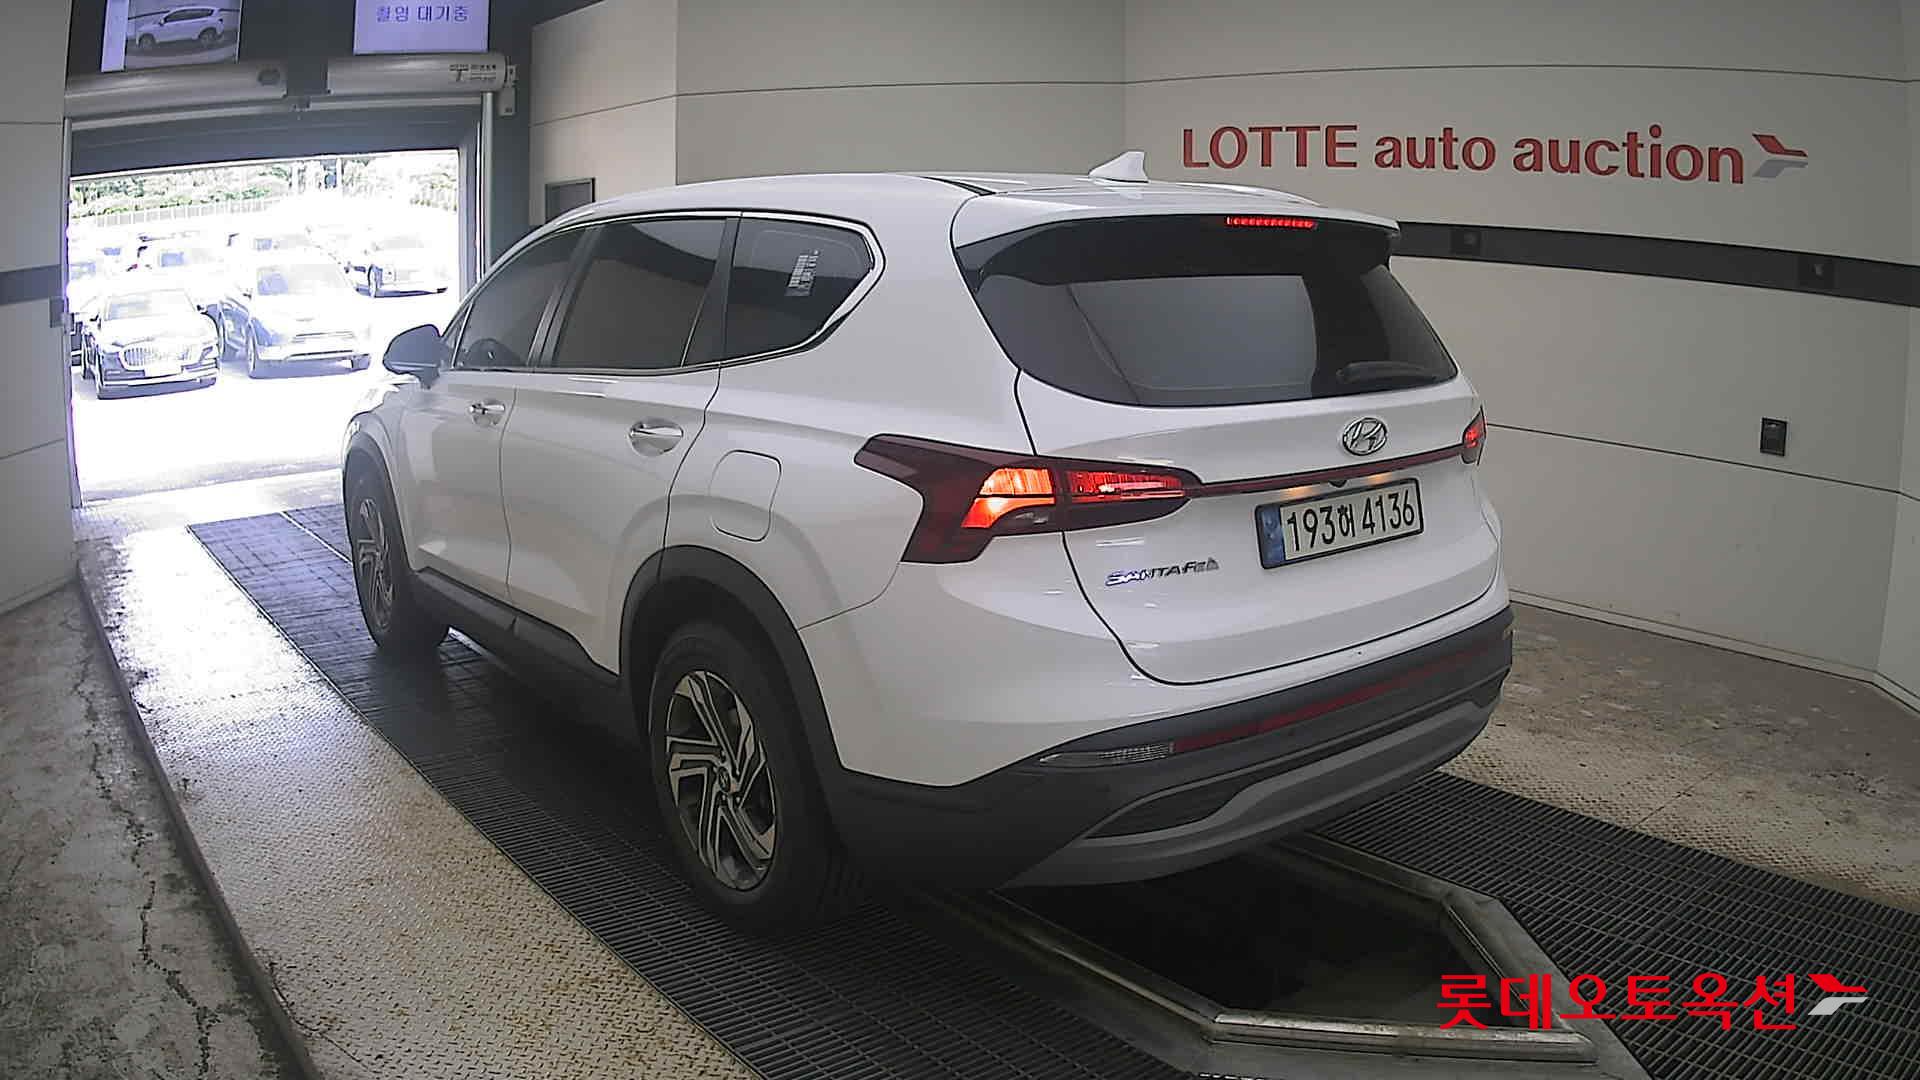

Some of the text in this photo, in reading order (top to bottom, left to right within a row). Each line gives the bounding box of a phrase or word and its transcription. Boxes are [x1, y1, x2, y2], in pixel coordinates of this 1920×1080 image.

[417, 5, 468, 22] 대기중
[1182, 123, 1745, 185] LOTTE auto auction
[1361, 489, 1415, 535] 4136
